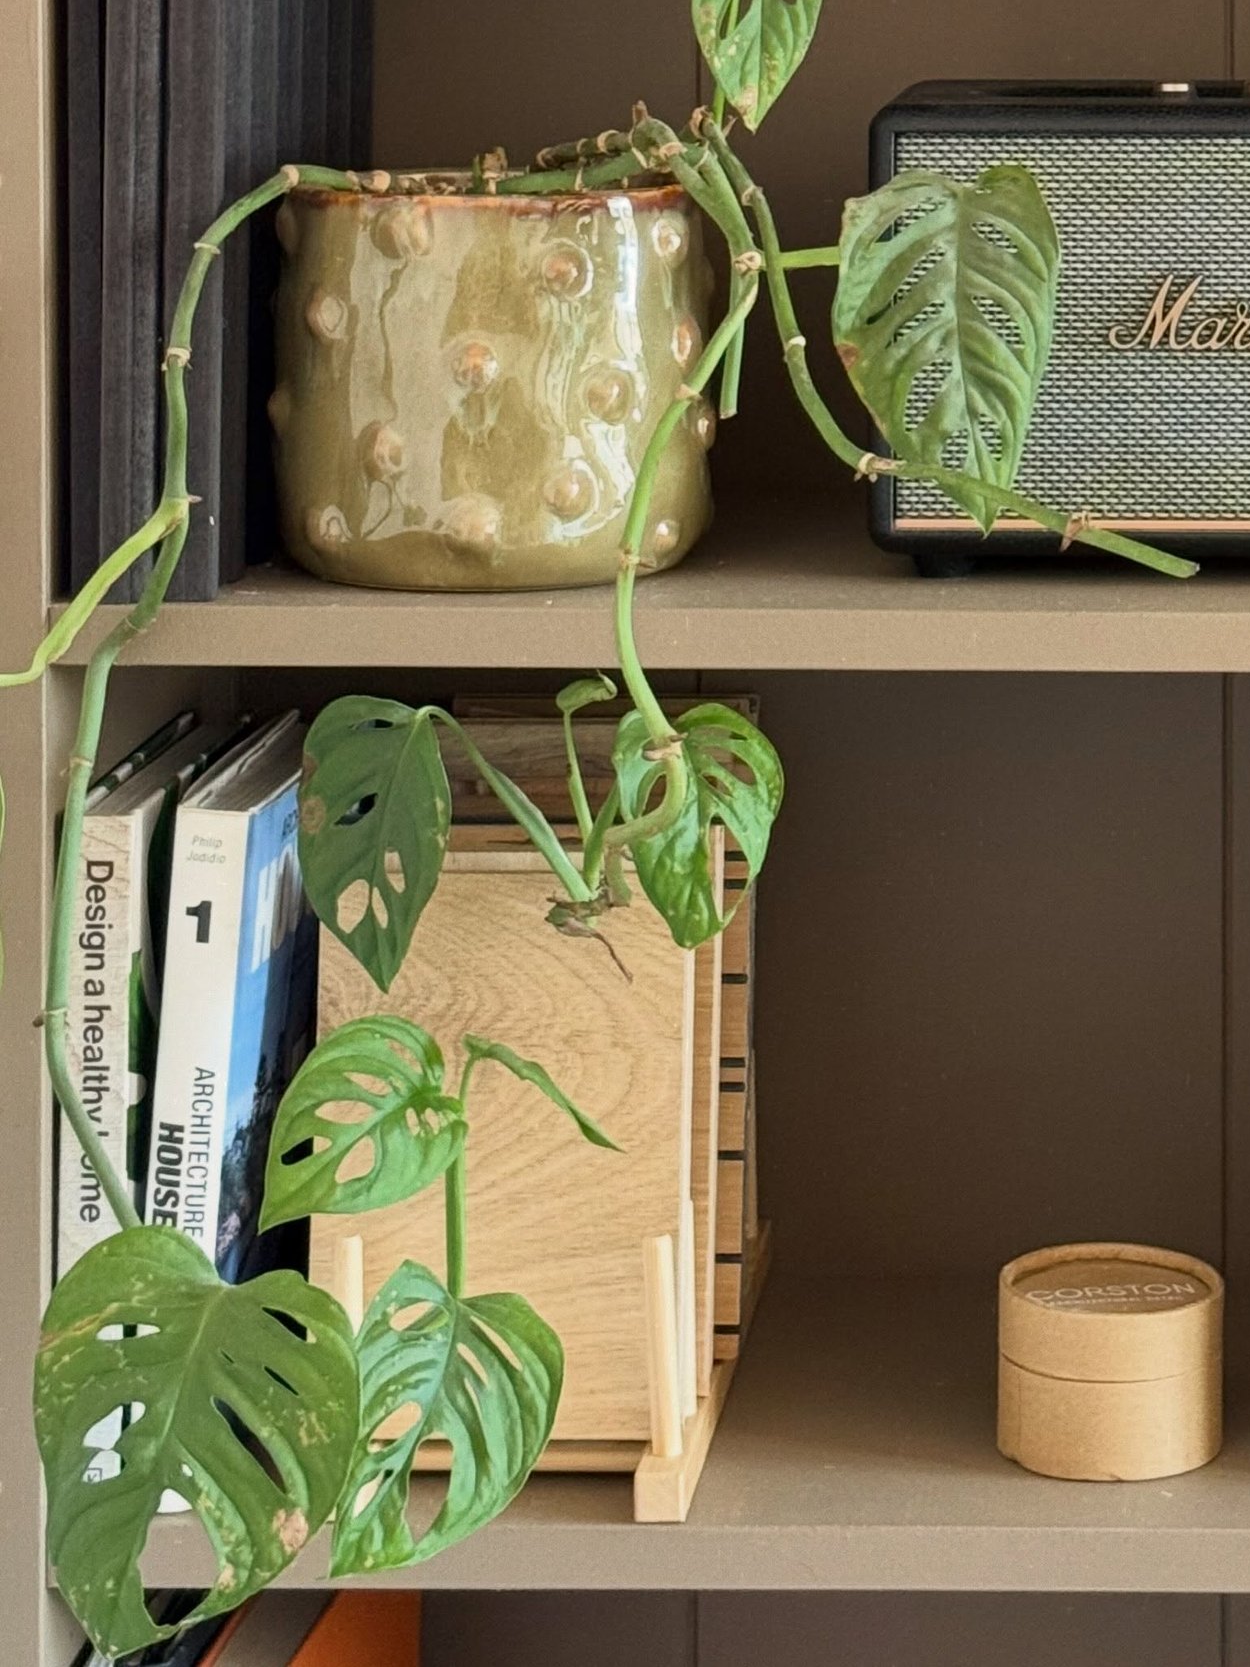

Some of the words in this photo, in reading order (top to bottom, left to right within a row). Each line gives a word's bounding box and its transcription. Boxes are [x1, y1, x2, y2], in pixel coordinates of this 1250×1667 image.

[191, 834, 223, 850] Philip
[185, 850, 226, 864] Jodidio
[78, 860, 114, 971] Design
[185, 899, 212, 944] 1
[83, 979, 105, 996] a
[184, 1066, 215, 1238] ARCHITECTURE
[1025, 1282, 1196, 1301] CORSTON
